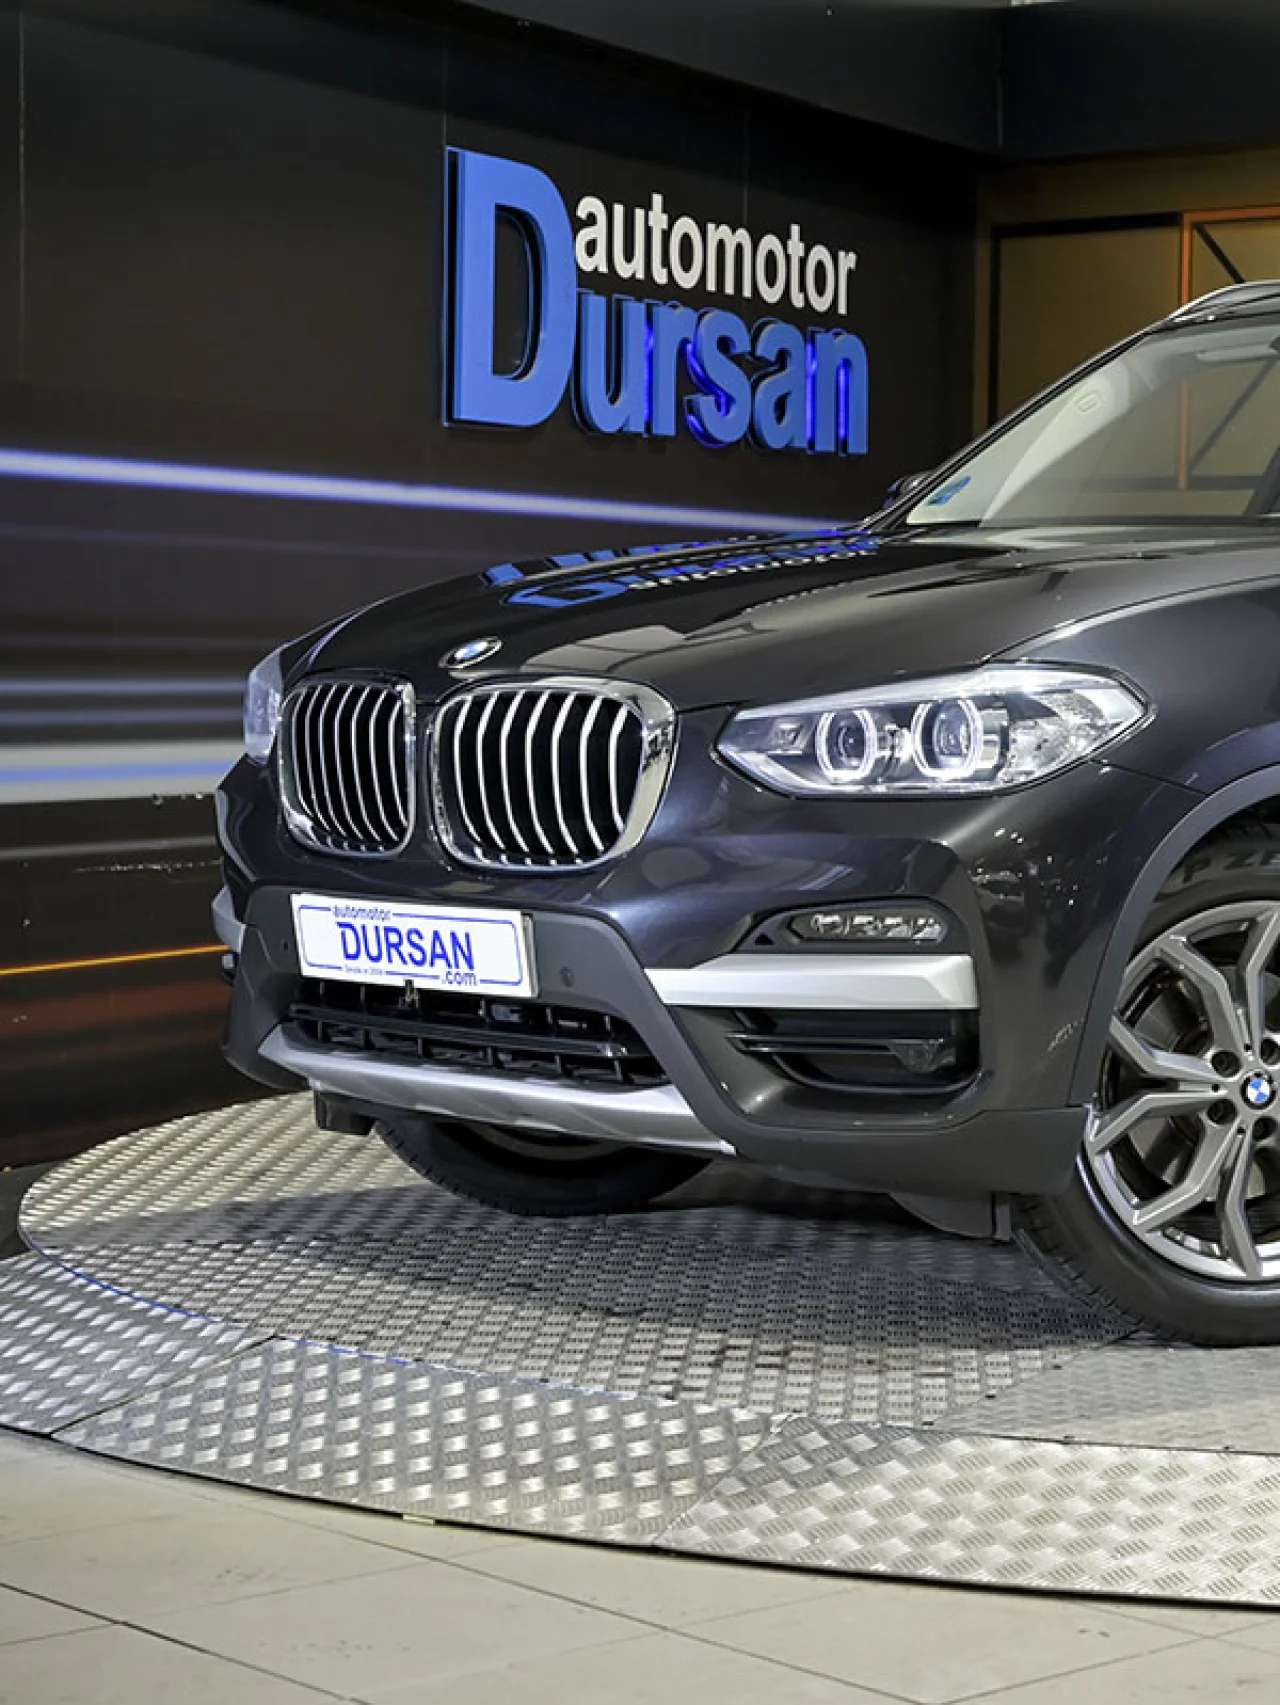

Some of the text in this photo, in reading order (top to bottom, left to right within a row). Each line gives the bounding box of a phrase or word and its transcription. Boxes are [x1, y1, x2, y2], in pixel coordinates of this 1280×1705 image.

[575, 191, 857, 315] automotor
[445, 146, 869, 455] Dursan
[333, 904, 391, 922] automotor
[336, 921, 476, 970] DURSAN
[441, 970, 478, 986] .com
